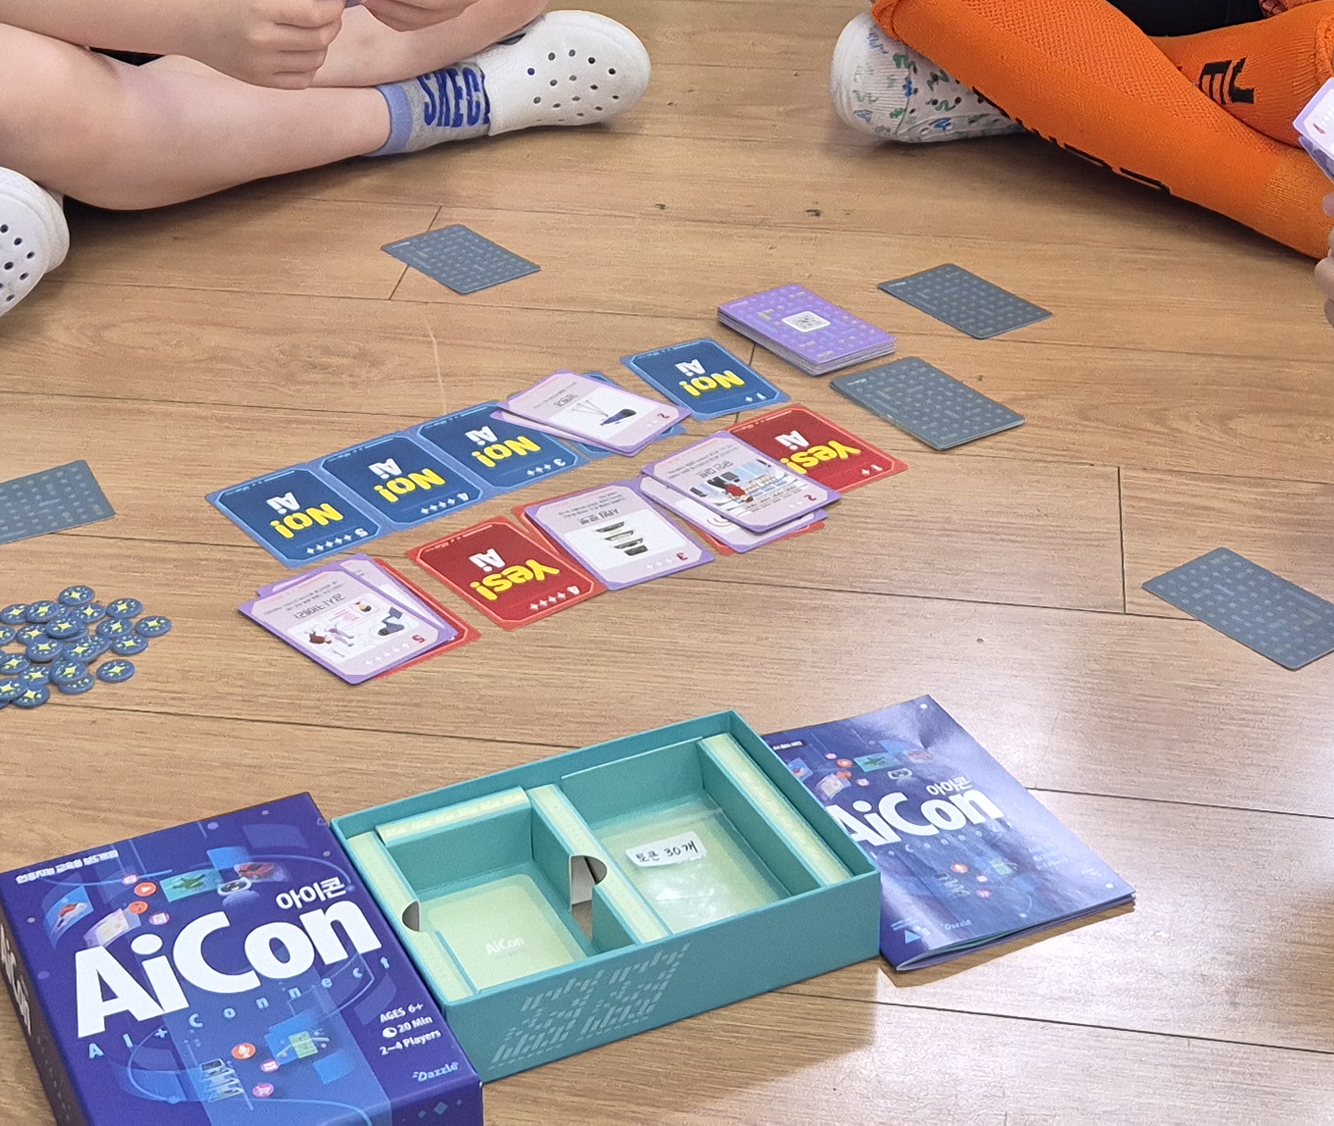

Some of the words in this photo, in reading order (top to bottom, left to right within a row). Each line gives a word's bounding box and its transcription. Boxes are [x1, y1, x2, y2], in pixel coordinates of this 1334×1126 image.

[674, 357, 707, 377] Ai
[680, 368, 746, 397] No!
[464, 424, 498, 447] Ai
[775, 428, 811, 451] Ai
[475, 434, 543, 469] No!
[780, 438, 862, 476] Yes!
[368, 457, 403, 480] Ai
[373, 467, 446, 504] No!
[266, 491, 302, 515] Ai
[269, 502, 345, 540] No!
[468, 546, 507, 573] Ai
[676, 551, 688, 562] 3
[470, 559, 561, 601] Yes!
[293, 600, 324, 621] 카메라
[412, 633, 427, 644] 5
[925, 775, 975, 798] 아이콘
[826, 788, 1006, 847] AiCon
[664, 839, 699, 858] 30개
[275, 878, 348, 911] 아이콘
[485, 935, 526, 956] AiCon
[74, 899, 383, 1039] AiCon
[378, 1005, 407, 1024] AGES
[408, 1001, 424, 1014] 6+
[397, 1021, 412, 1034] 20
[412, 1014, 433, 1028] Min
[402, 1028, 442, 1050] Players
[417, 1061, 460, 1082] Dazzle
